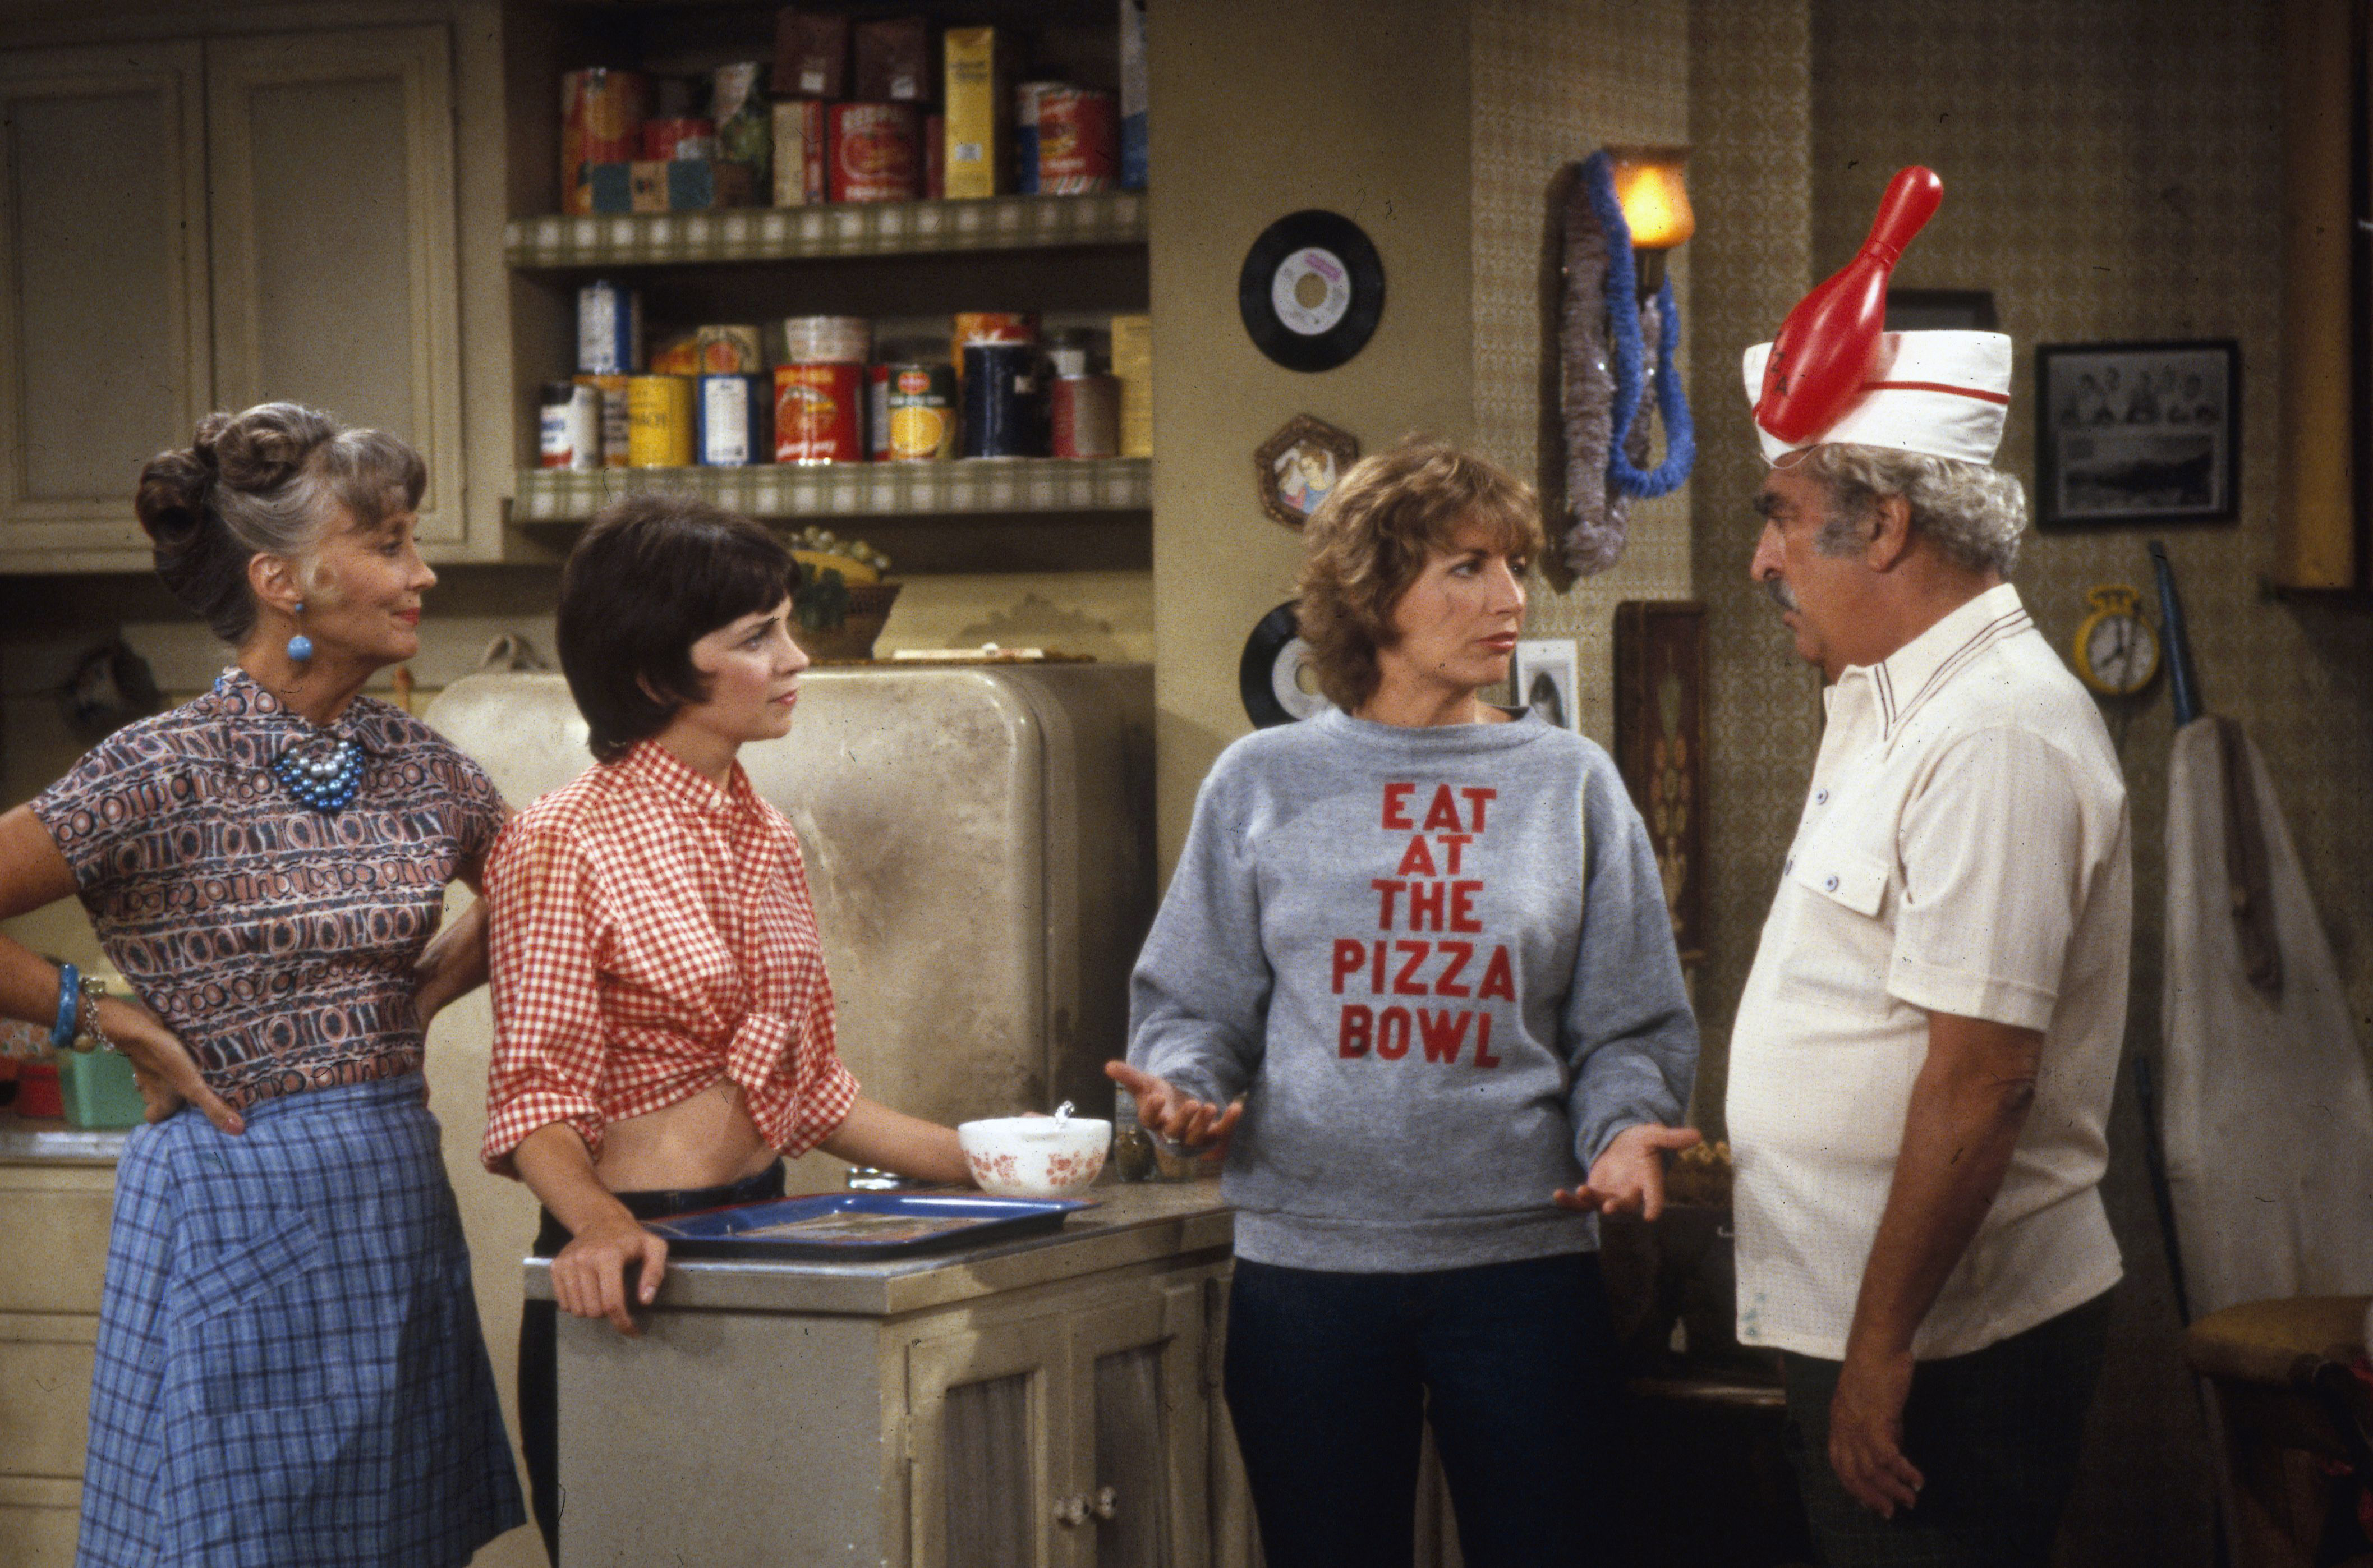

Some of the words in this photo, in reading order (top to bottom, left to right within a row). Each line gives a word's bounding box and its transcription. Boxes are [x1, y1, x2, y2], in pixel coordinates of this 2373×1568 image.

[1382, 783, 1497, 833] EAT
[1397, 834, 1473, 877] AT
[1371, 879, 1483, 932] THE
[1332, 939, 1516, 1002] PIZZA
[1339, 1004, 1501, 1068] BOWL
